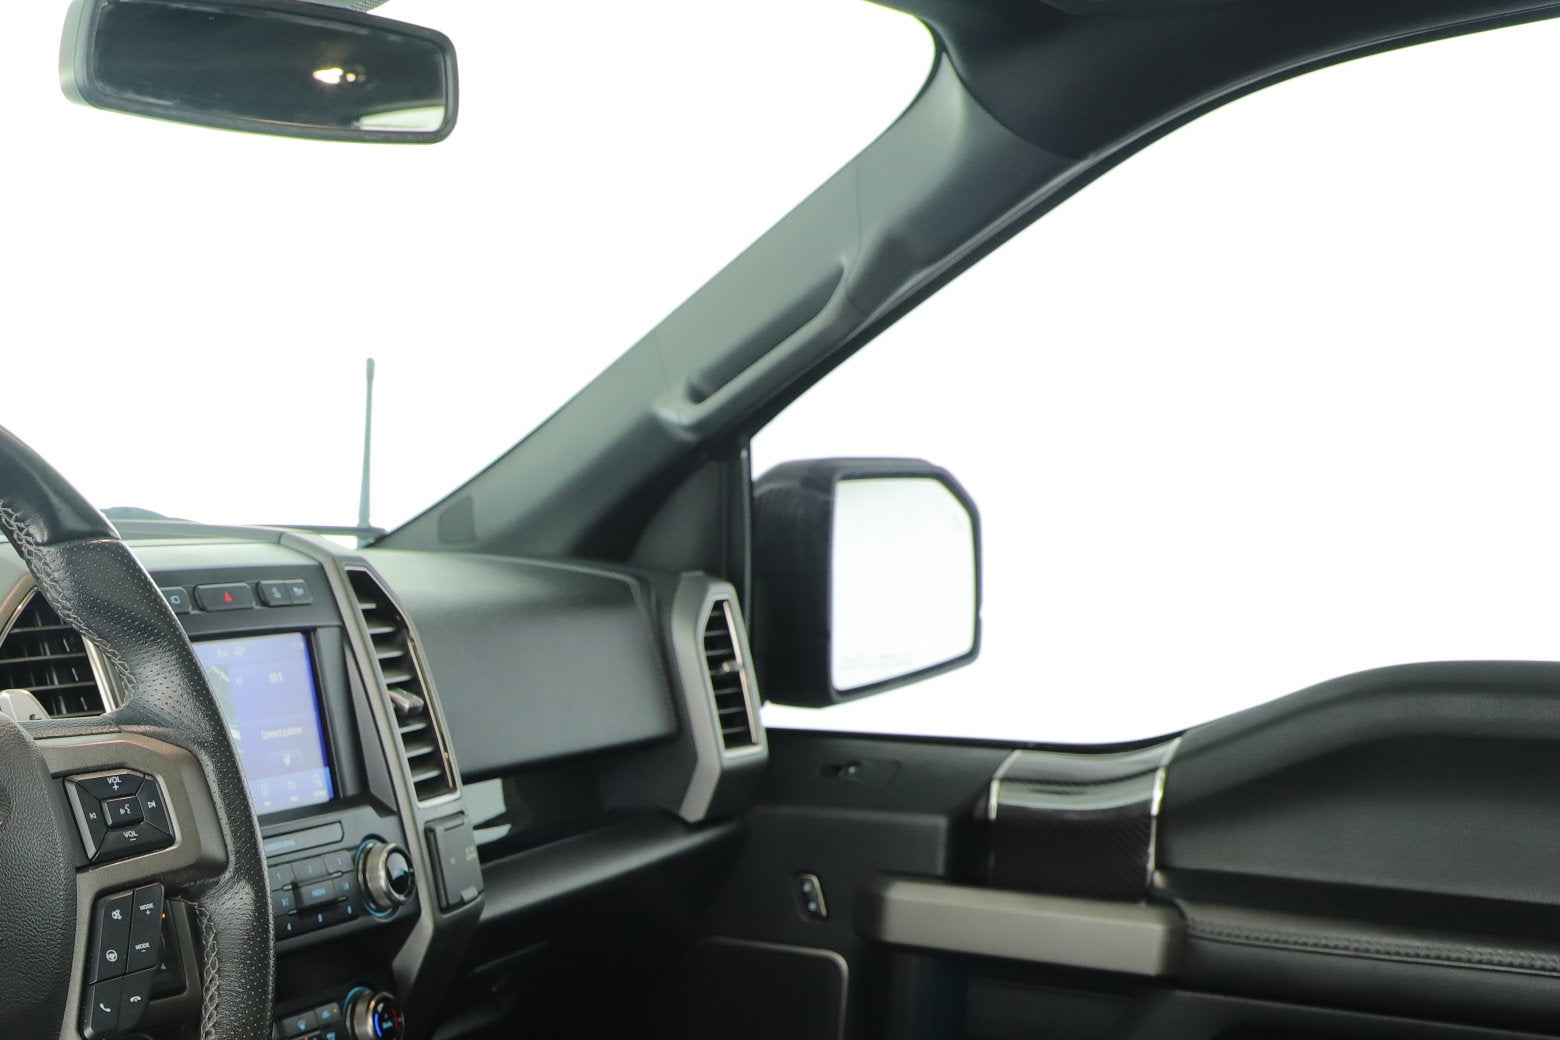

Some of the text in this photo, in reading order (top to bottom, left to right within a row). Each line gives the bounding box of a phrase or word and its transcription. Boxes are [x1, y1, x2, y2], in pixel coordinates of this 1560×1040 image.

[107, 775, 122, 785] VOL
[123, 830, 138, 838] VOL
[139, 902, 154, 910] MODE
[135, 942, 150, 950] MODE
